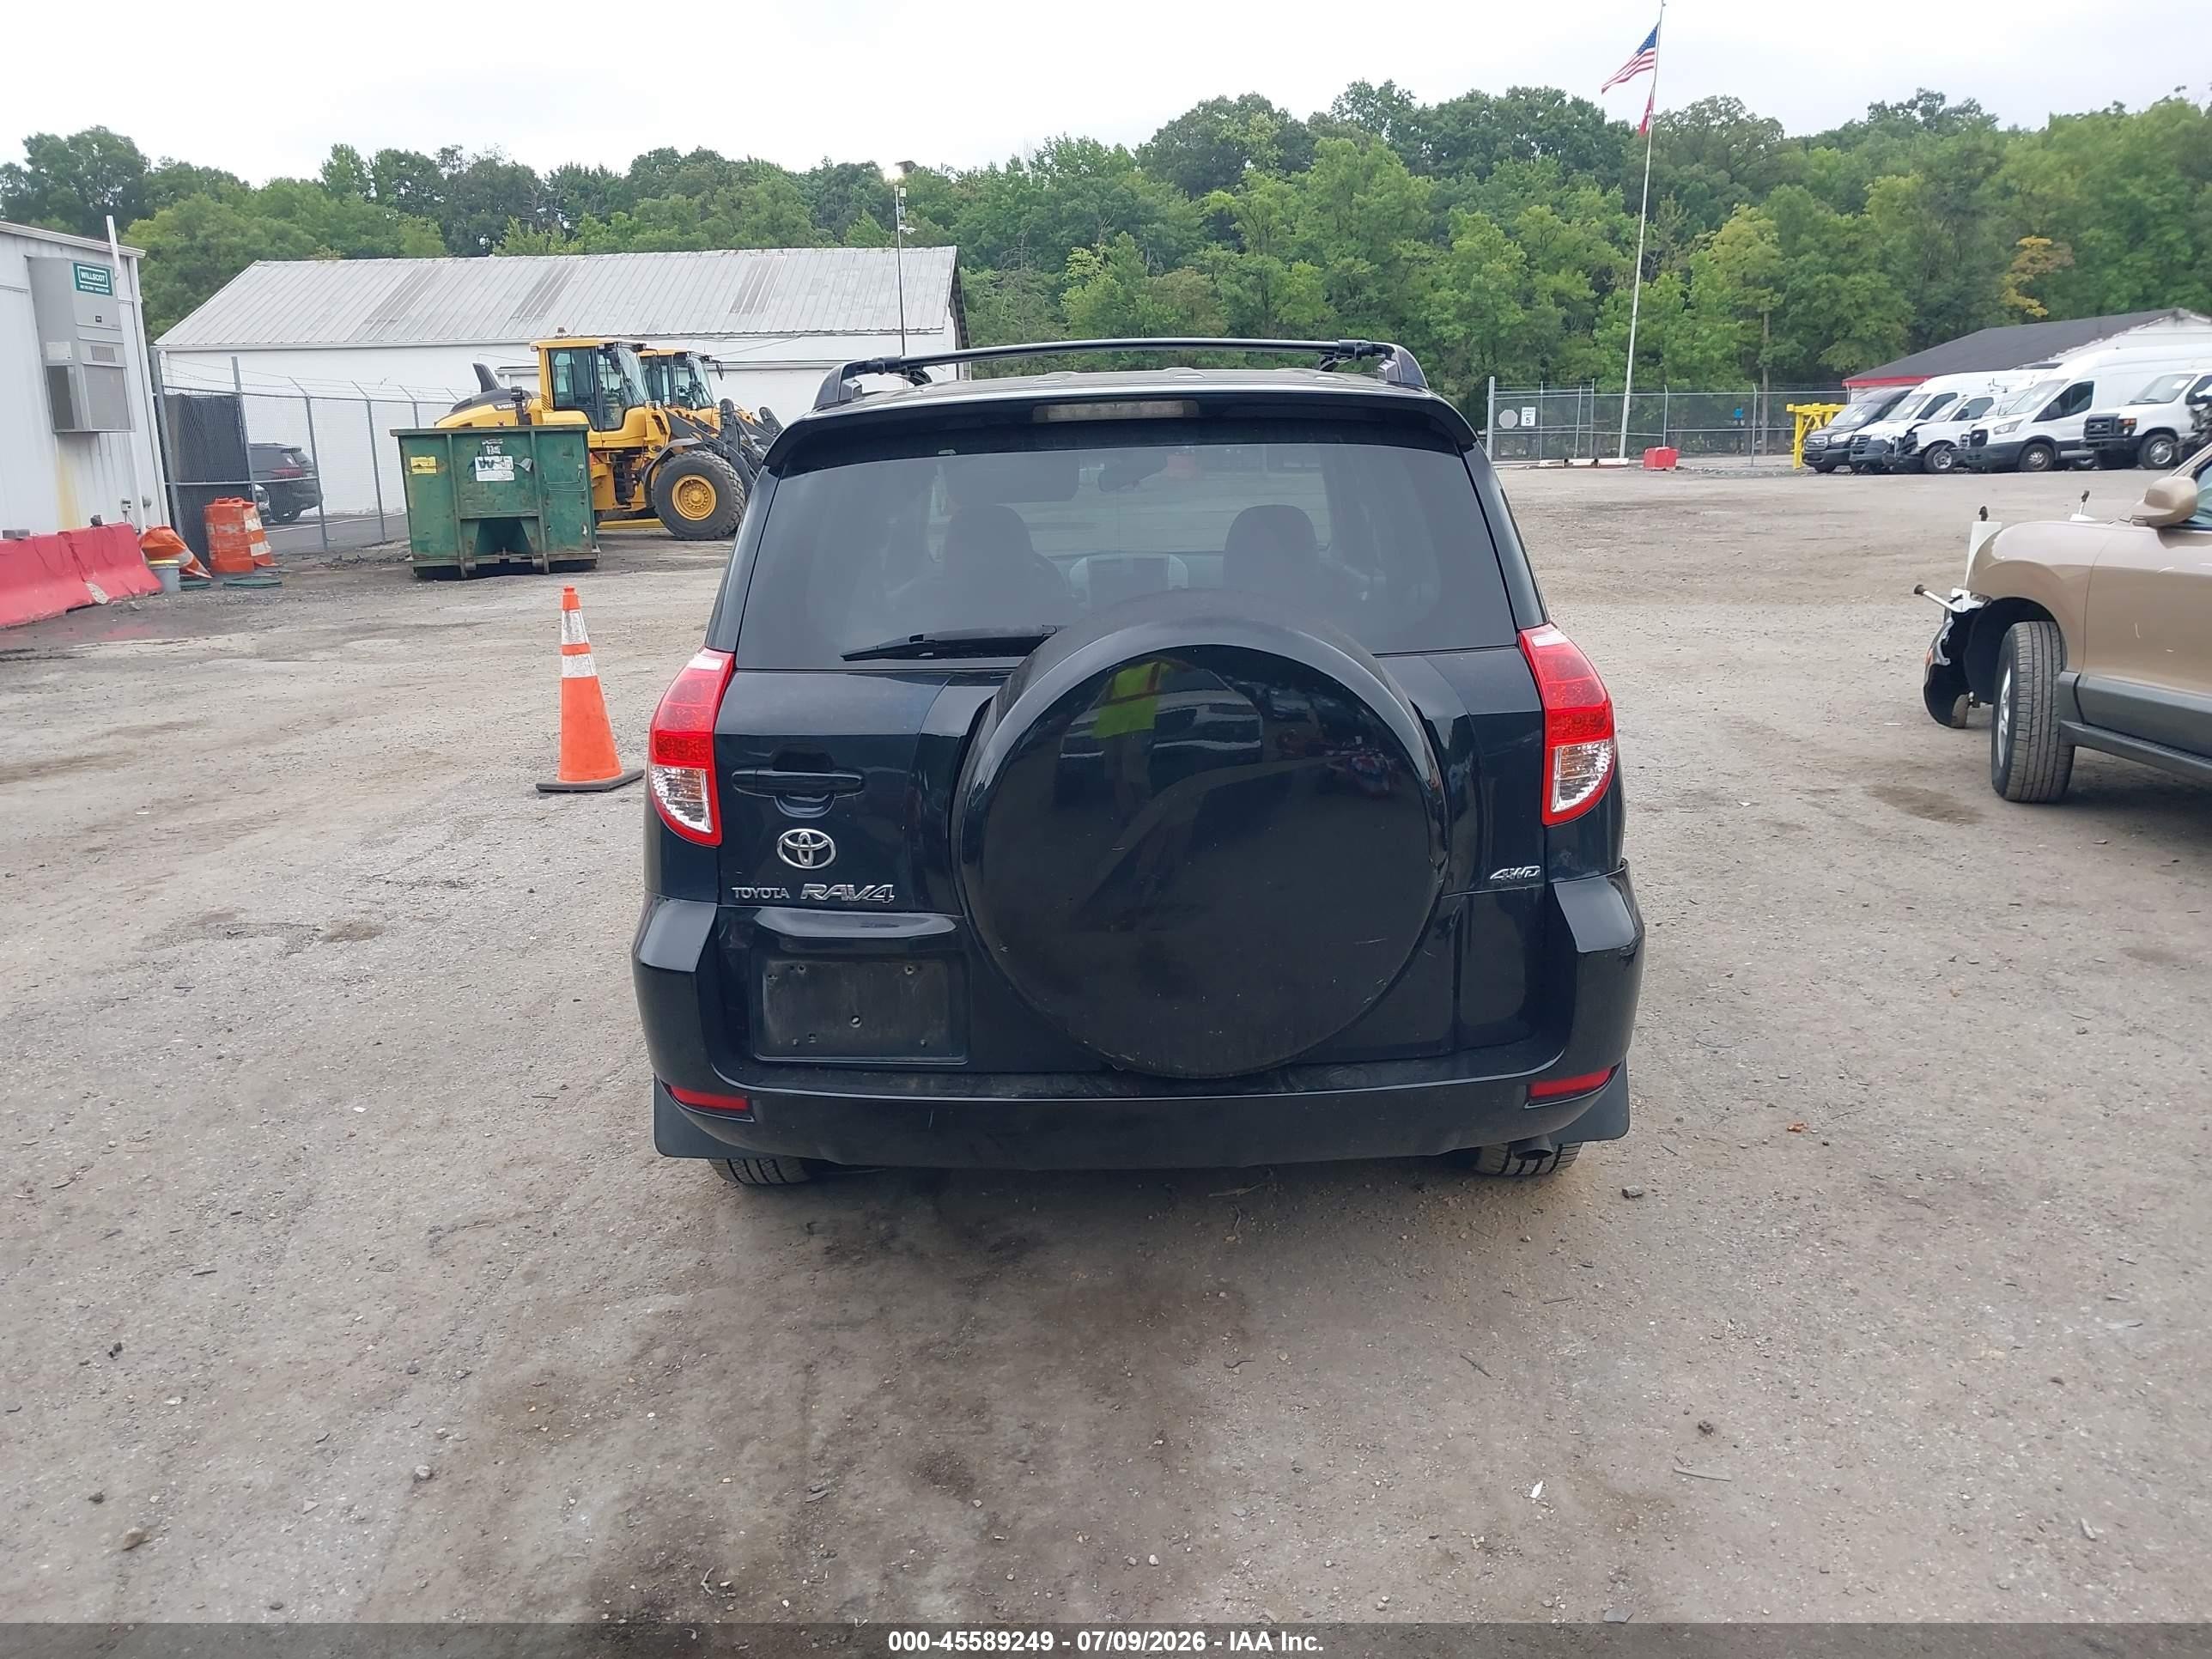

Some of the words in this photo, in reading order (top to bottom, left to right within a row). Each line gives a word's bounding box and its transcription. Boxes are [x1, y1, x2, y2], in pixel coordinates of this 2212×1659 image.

[1489, 865, 1541, 880] 4WD
[732, 887, 791, 900] TOYOTA
[799, 883, 896, 903] RAV4
